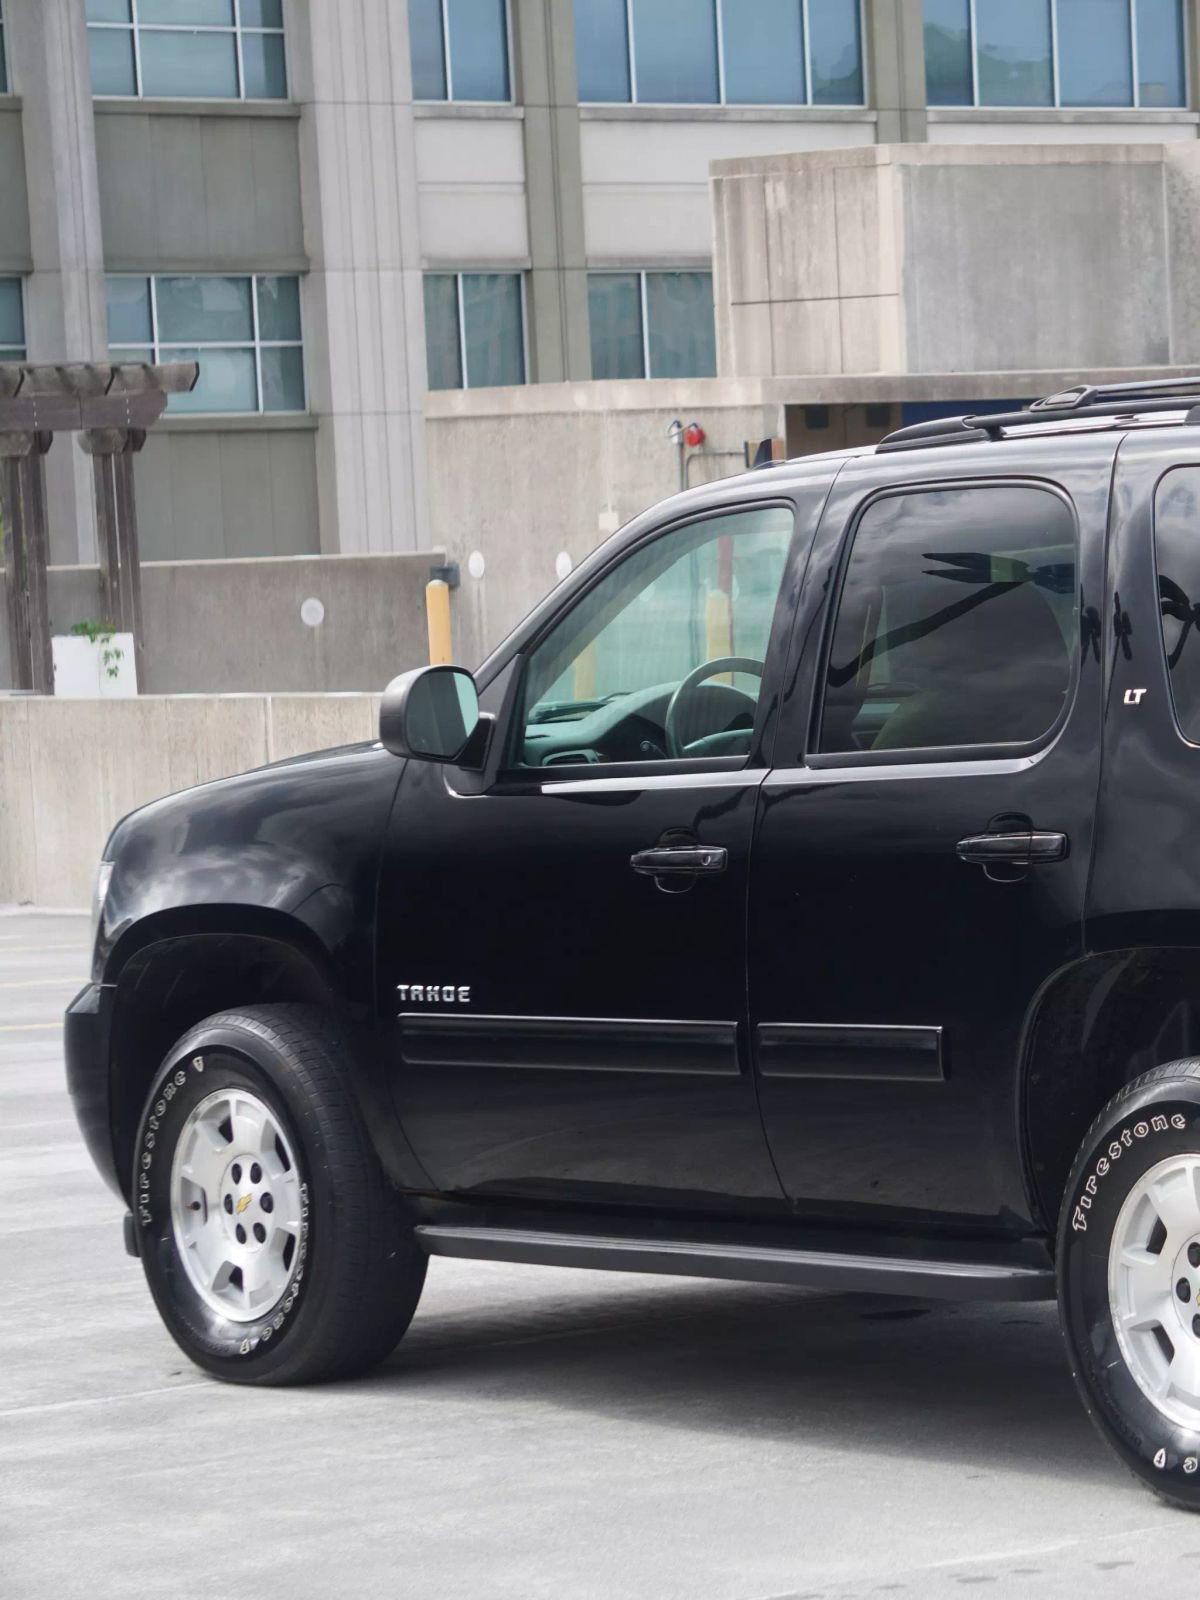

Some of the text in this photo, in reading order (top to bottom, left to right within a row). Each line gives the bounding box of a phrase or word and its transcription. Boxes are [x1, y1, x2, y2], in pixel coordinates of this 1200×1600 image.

[1123, 688, 1147, 705] LT
[396, 984, 471, 1003] TAHOE
[1072, 1113, 1186, 1232] Firestone
